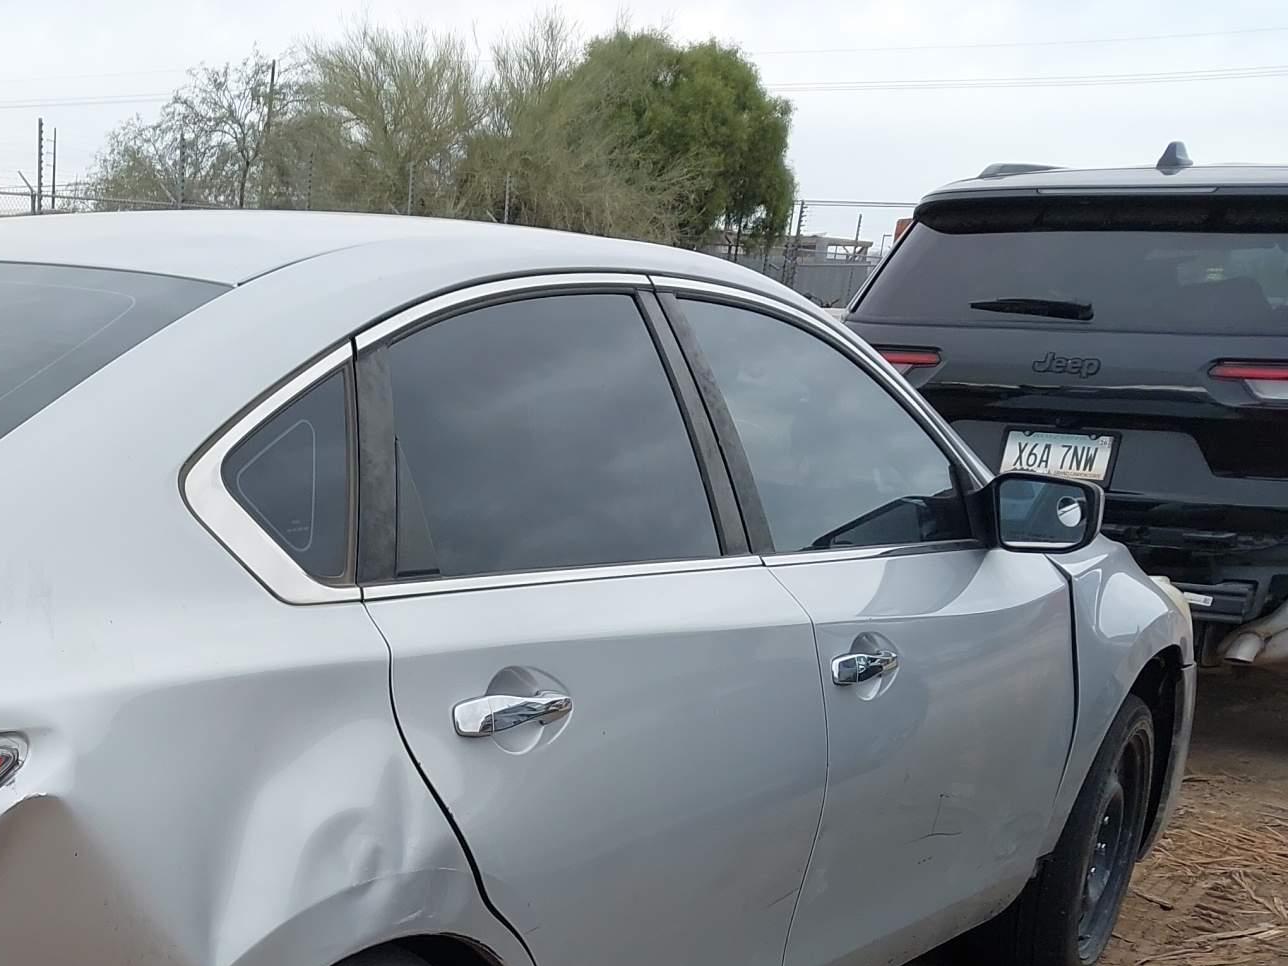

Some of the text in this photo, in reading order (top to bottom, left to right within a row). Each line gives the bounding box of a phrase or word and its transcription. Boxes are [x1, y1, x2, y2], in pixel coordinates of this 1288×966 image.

[1032, 351, 1101, 379] Jeep
[1013, 442, 1099, 472] X6A 7NW
